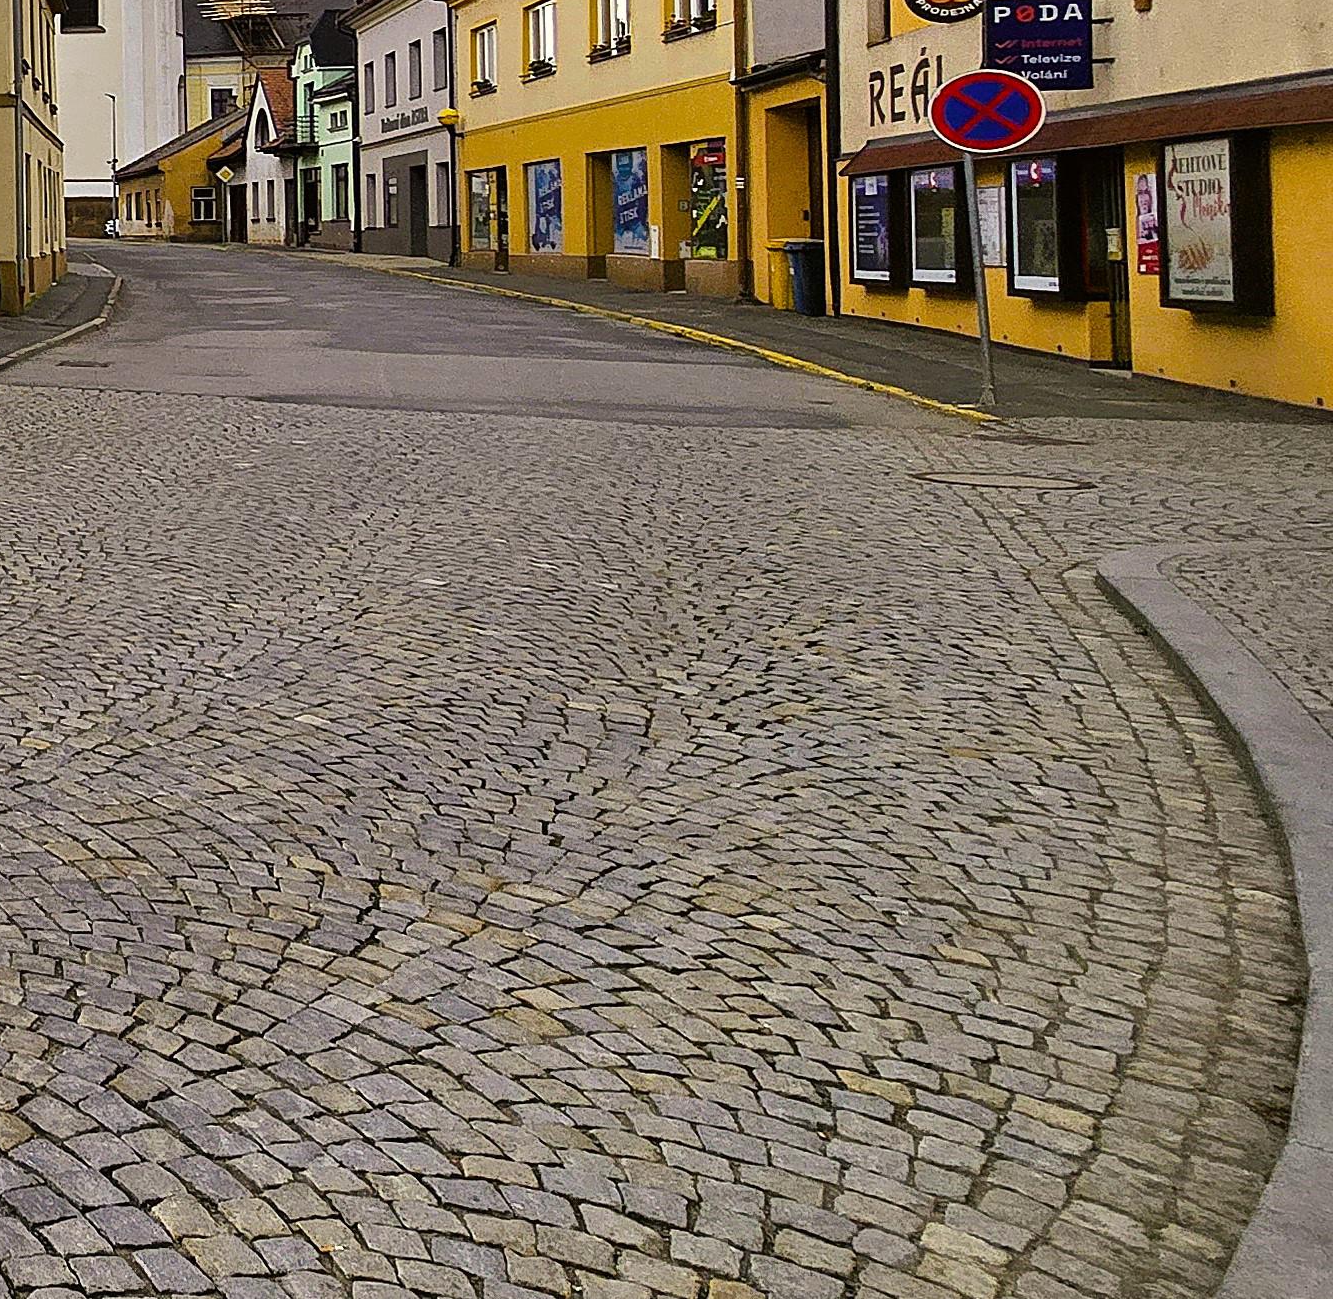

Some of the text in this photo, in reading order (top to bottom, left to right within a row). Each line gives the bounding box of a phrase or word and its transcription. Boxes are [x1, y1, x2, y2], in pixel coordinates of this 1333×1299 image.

[994, 3, 1084, 24] PODA
[1021, 37, 1084, 49] Internet
[1021, 53, 1082, 65] Televize
[1021, 69, 1068, 80] Volání
[617, 184, 649, 206] REKLAMA
[1176, 177, 1221, 200] STUDIO
